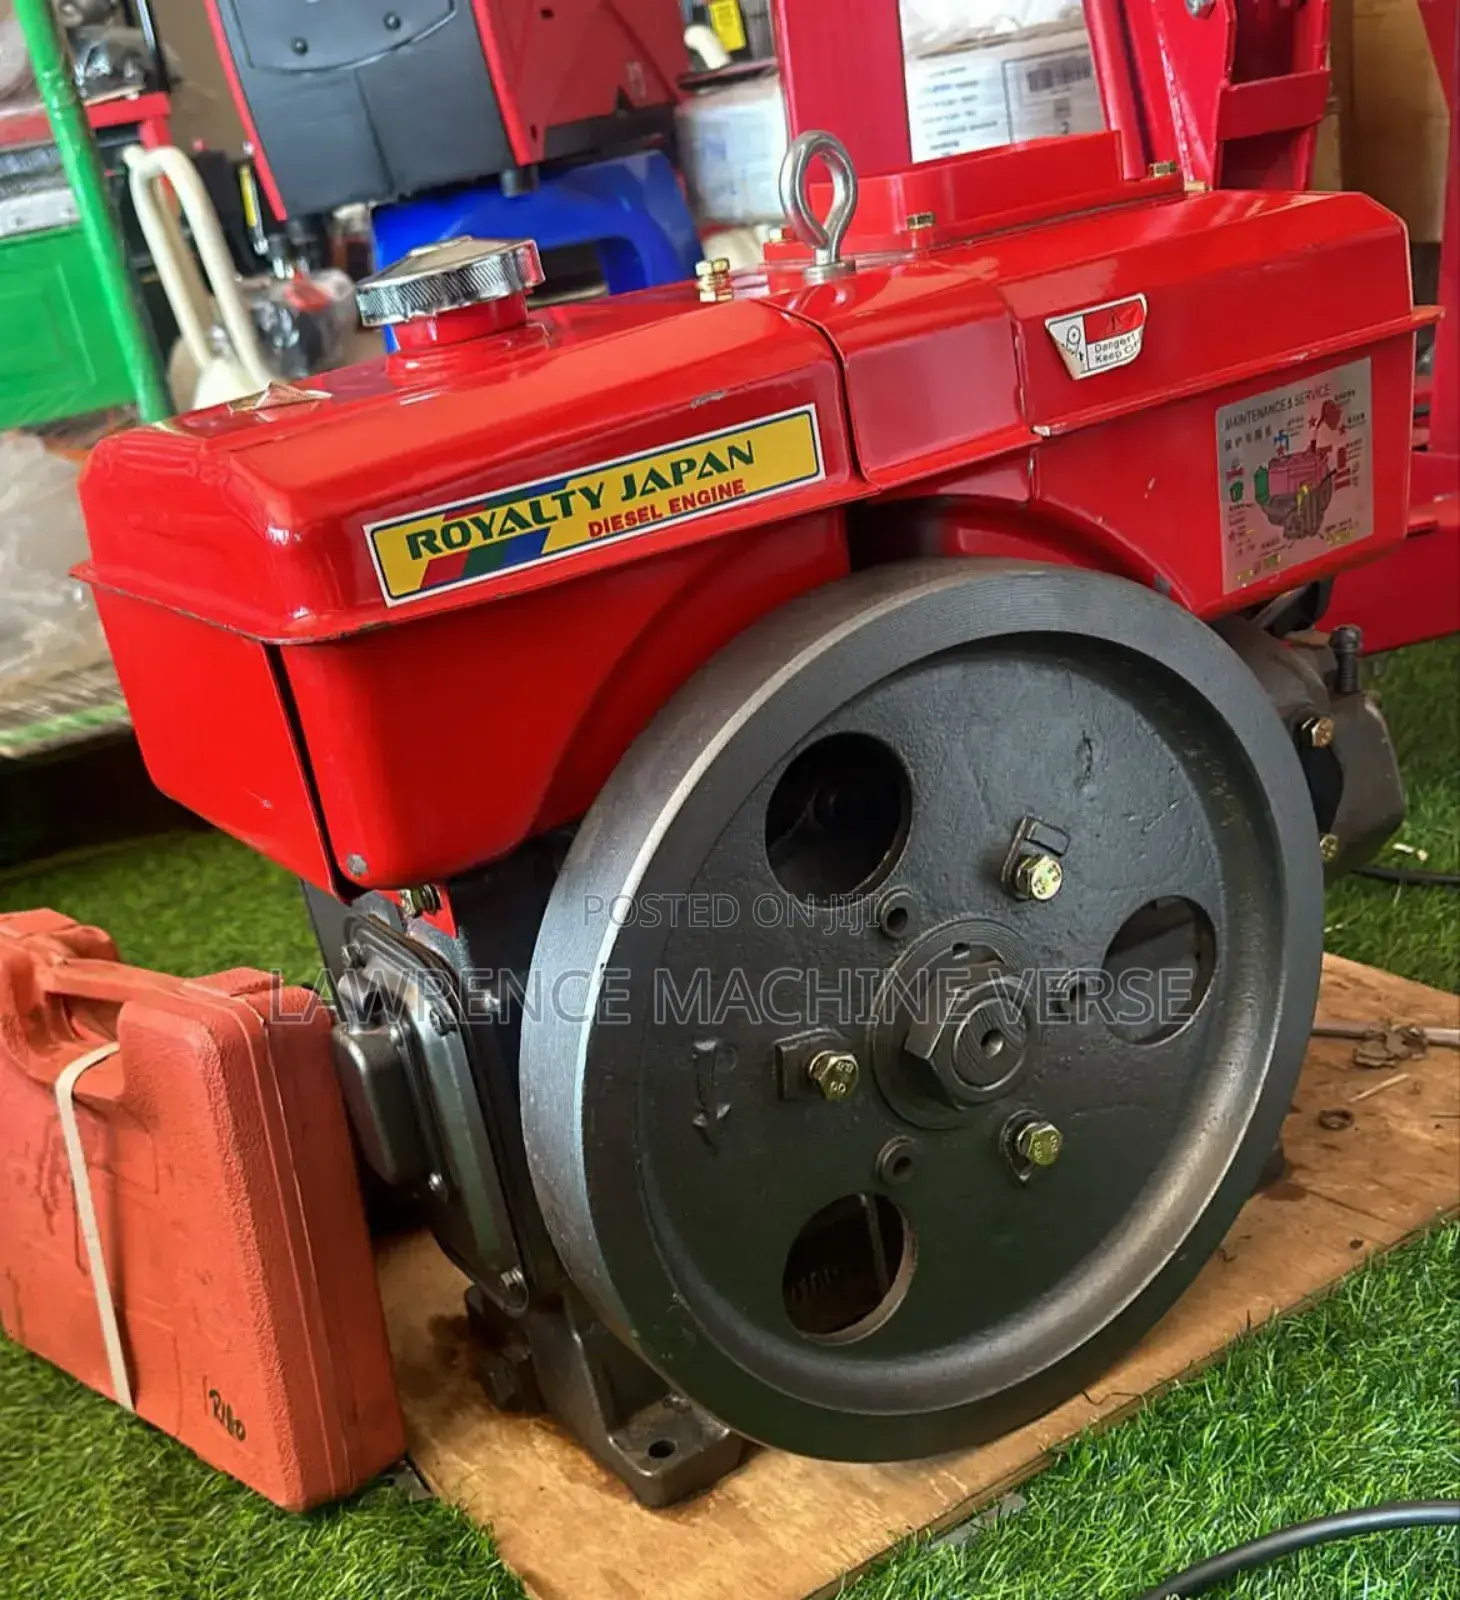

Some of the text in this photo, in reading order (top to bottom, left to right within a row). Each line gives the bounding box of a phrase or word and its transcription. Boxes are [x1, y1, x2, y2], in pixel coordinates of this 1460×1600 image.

[405, 439, 755, 561] ROYALTY JAPAN
[588, 478, 746, 538] DIESEL ENGINE
